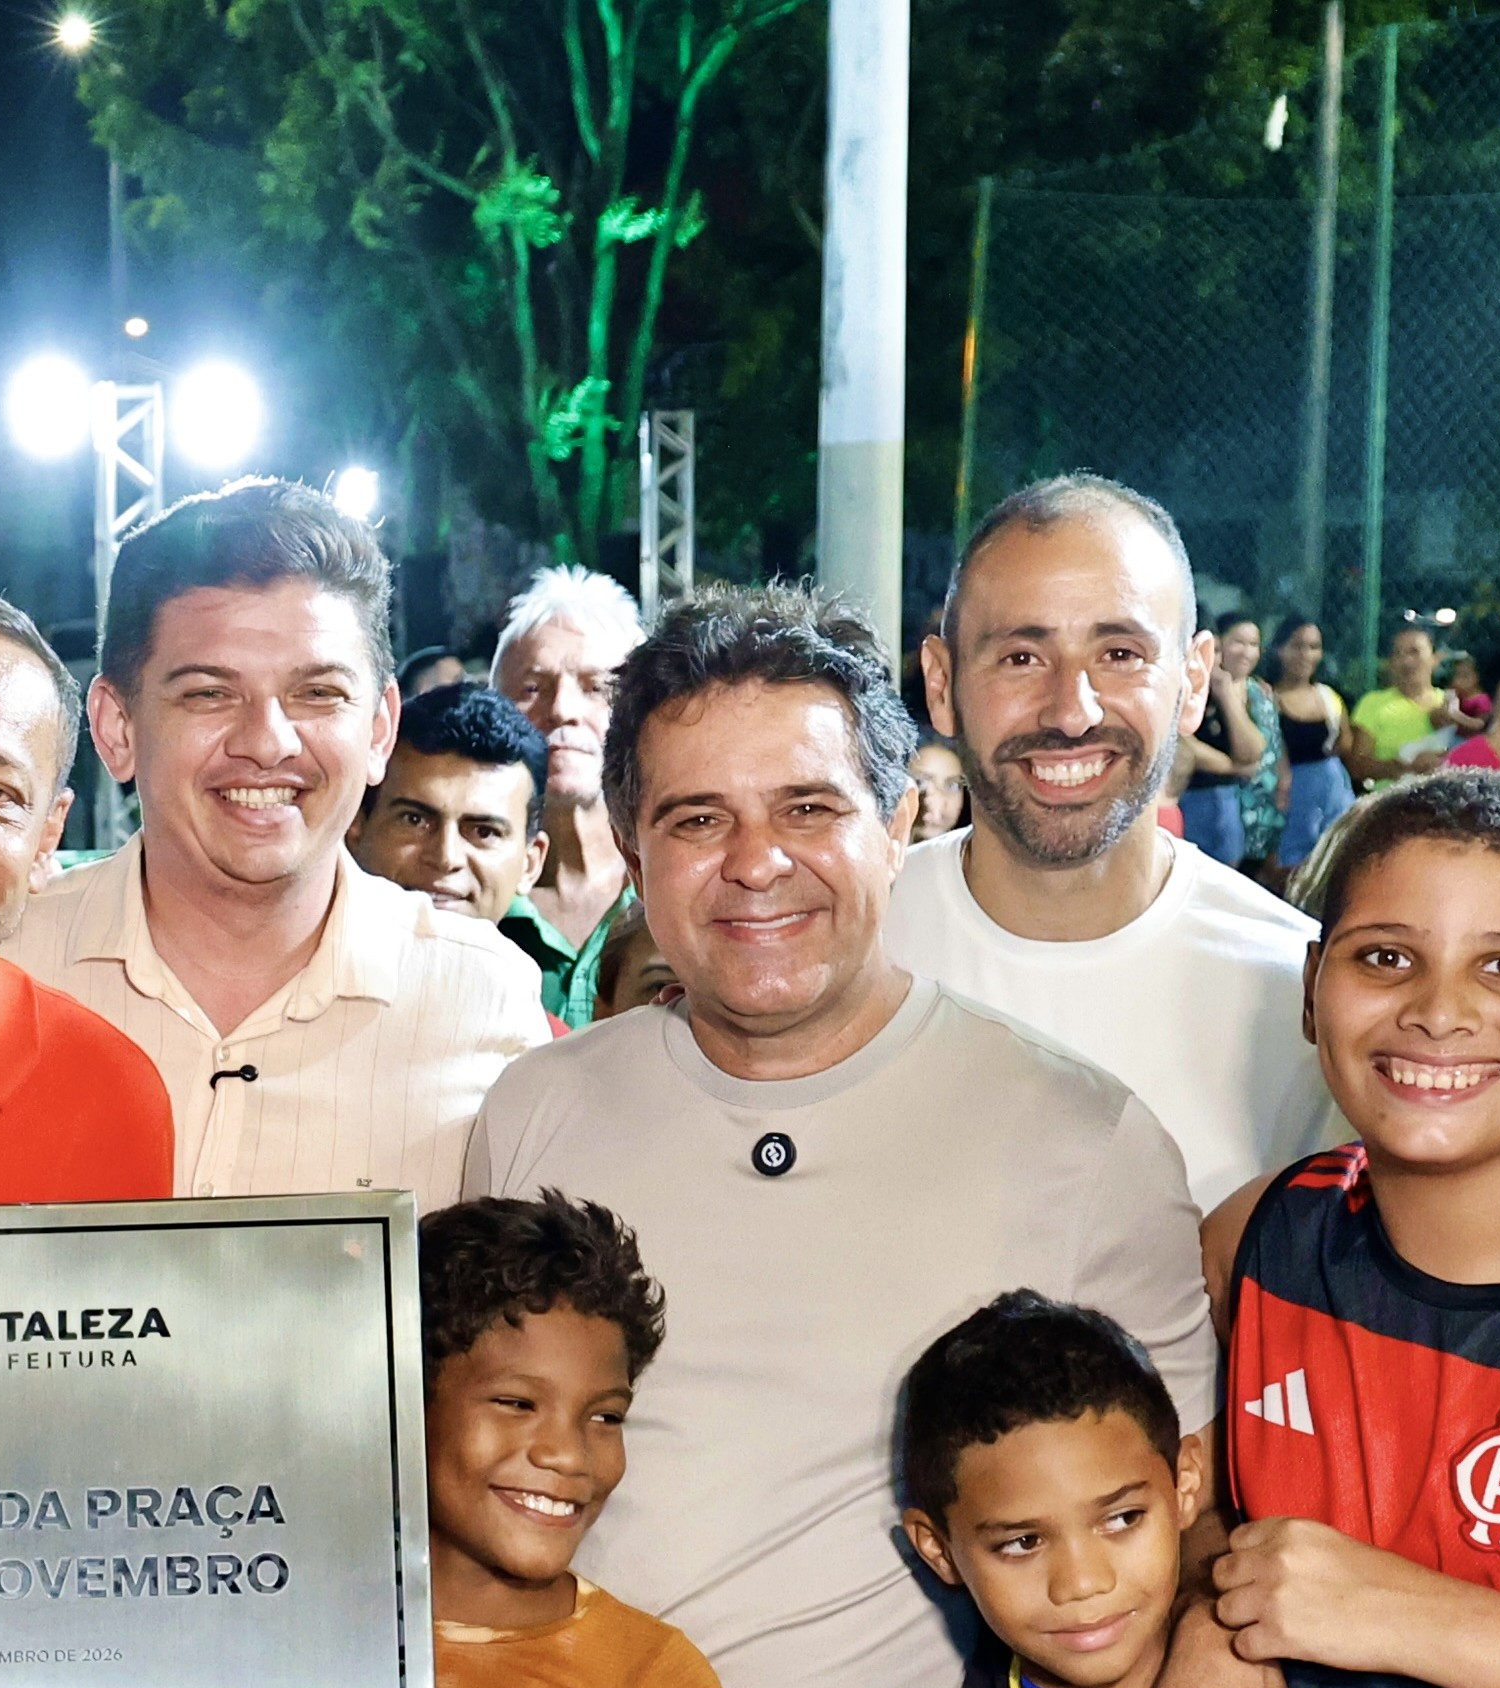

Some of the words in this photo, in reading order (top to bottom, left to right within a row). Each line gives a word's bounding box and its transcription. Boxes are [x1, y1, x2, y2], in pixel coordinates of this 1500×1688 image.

[86, 1484, 287, 1539] PRAÇA
[55, 1649, 77, 1662] DE
[82, 1648, 123, 1662] 2026
